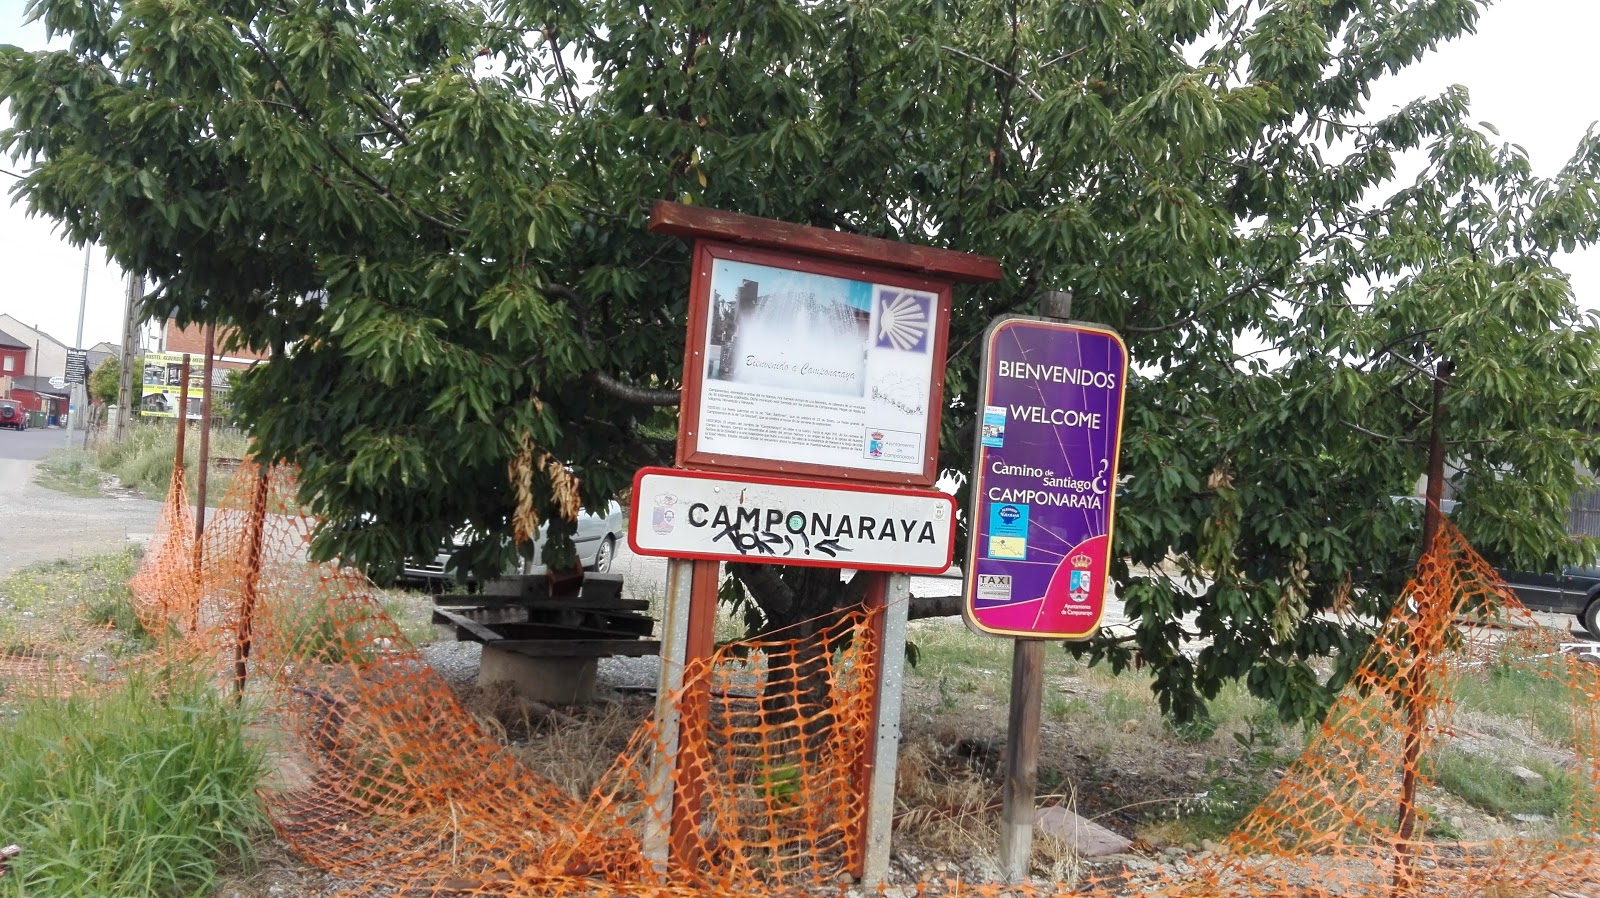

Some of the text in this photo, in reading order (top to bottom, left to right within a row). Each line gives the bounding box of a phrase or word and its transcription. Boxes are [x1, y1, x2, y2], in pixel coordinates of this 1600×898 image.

[746, 355, 789, 371] Bienvenido
[800, 362, 856, 381] Camponaraya
[998, 360, 1116, 389] BIENVENIDOS
[1009, 404, 1101, 430] WELCOME
[992, 461, 1043, 478] Camino
[988, 487, 1102, 510] CAMPONARAYA
[688, 502, 936, 545] CAMPONARAYA
[980, 575, 1010, 585] TAXI
